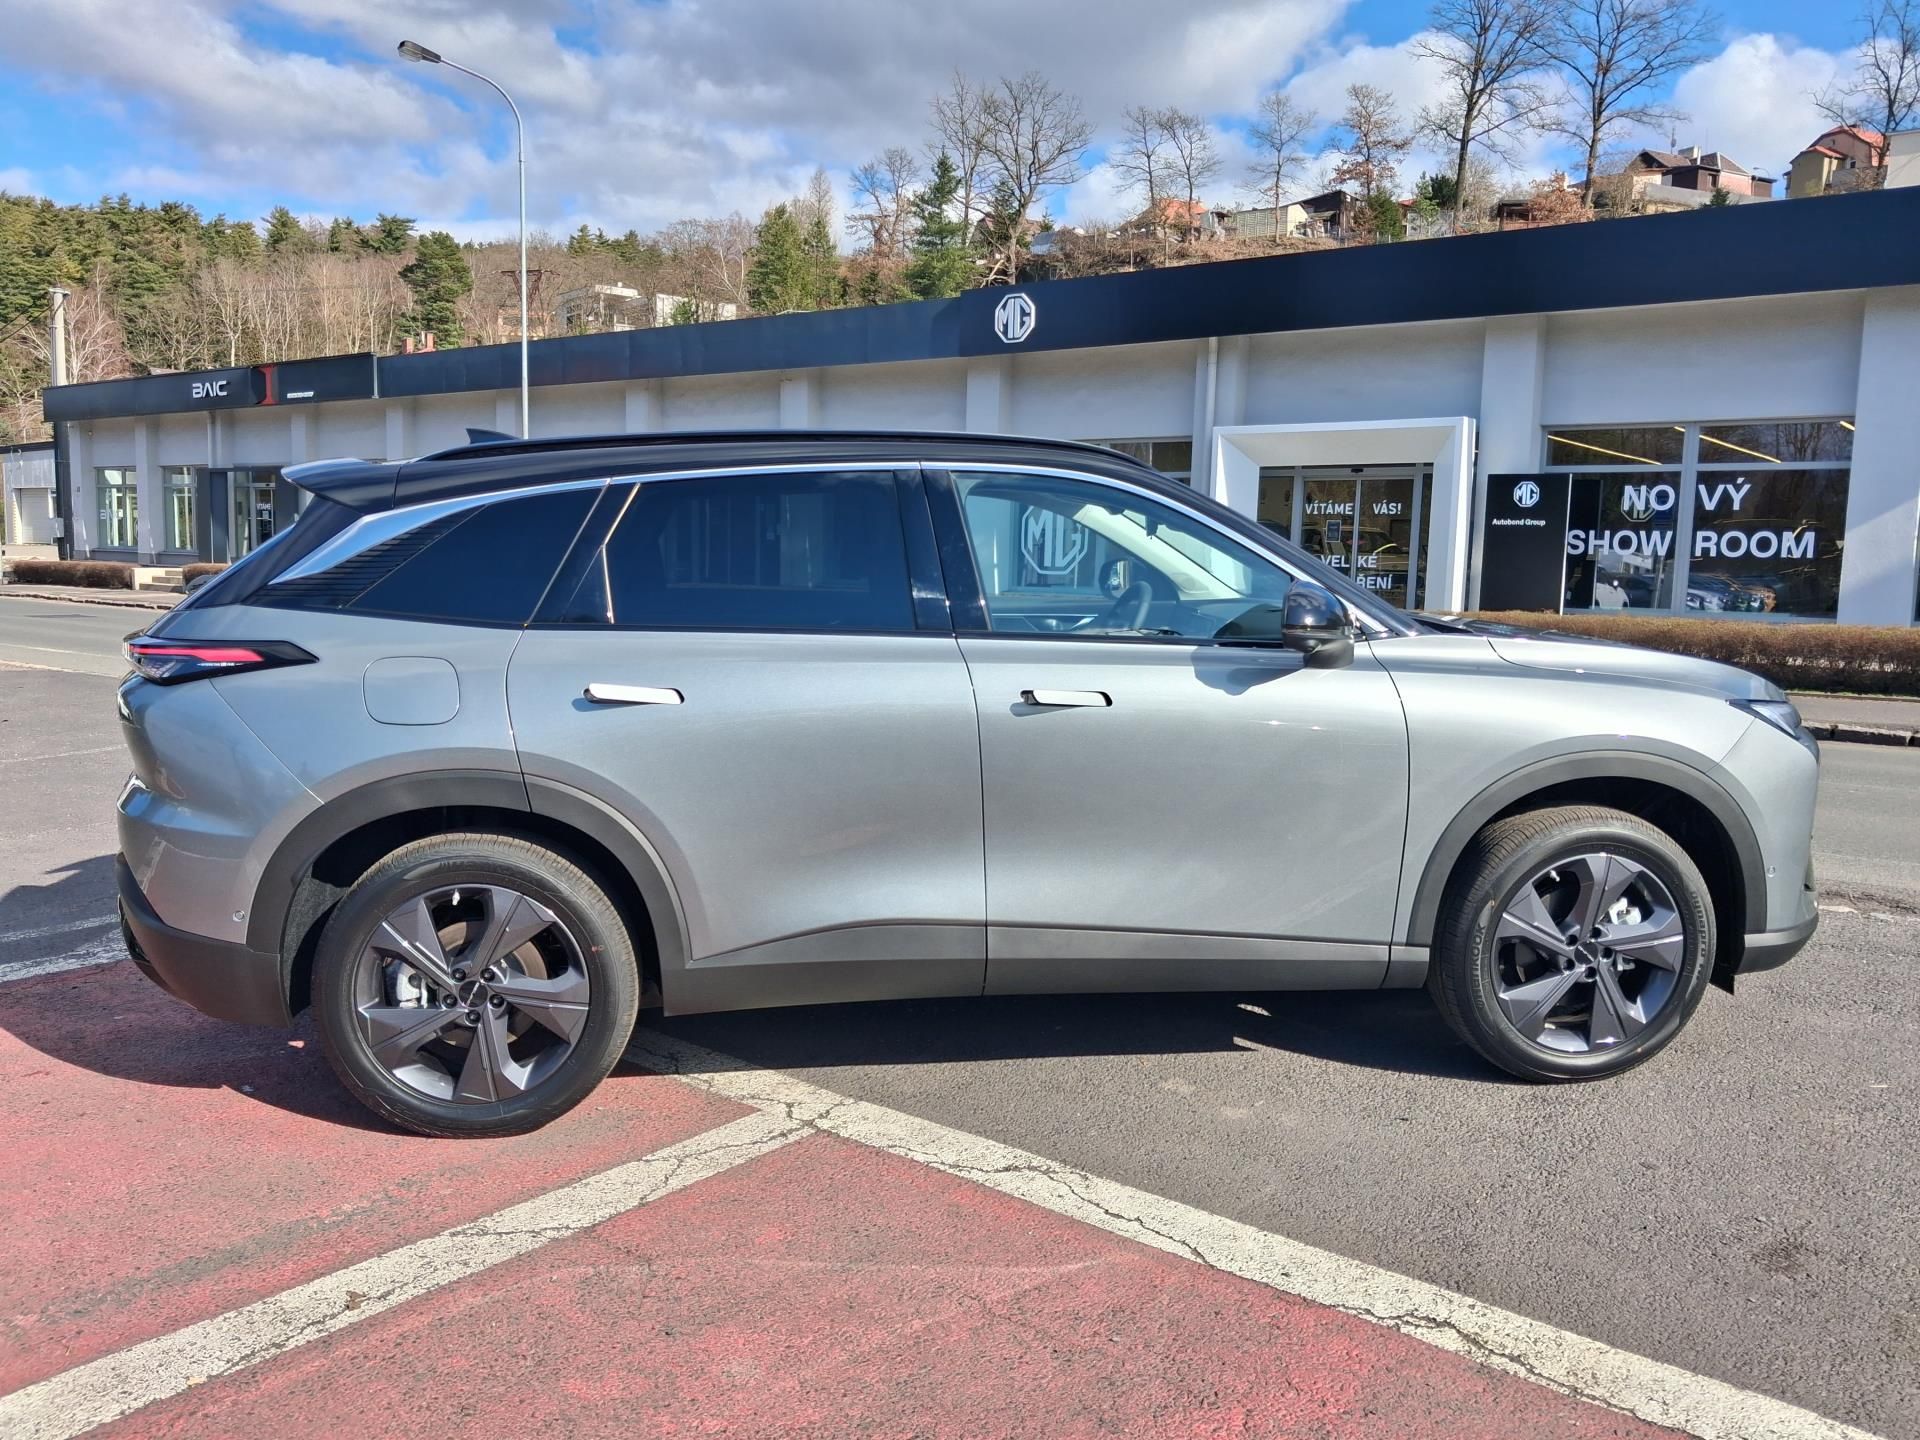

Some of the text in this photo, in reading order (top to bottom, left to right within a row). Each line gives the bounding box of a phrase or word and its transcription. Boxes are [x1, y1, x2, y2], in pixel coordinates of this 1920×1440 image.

[998, 297, 1031, 339] MG
[192, 380, 227, 398] BAIC
[1516, 483, 1537, 505] MG
[1305, 500, 1402, 515] VÍTÁME VÁS!
[1492, 518, 1546, 527] Autobond Group
